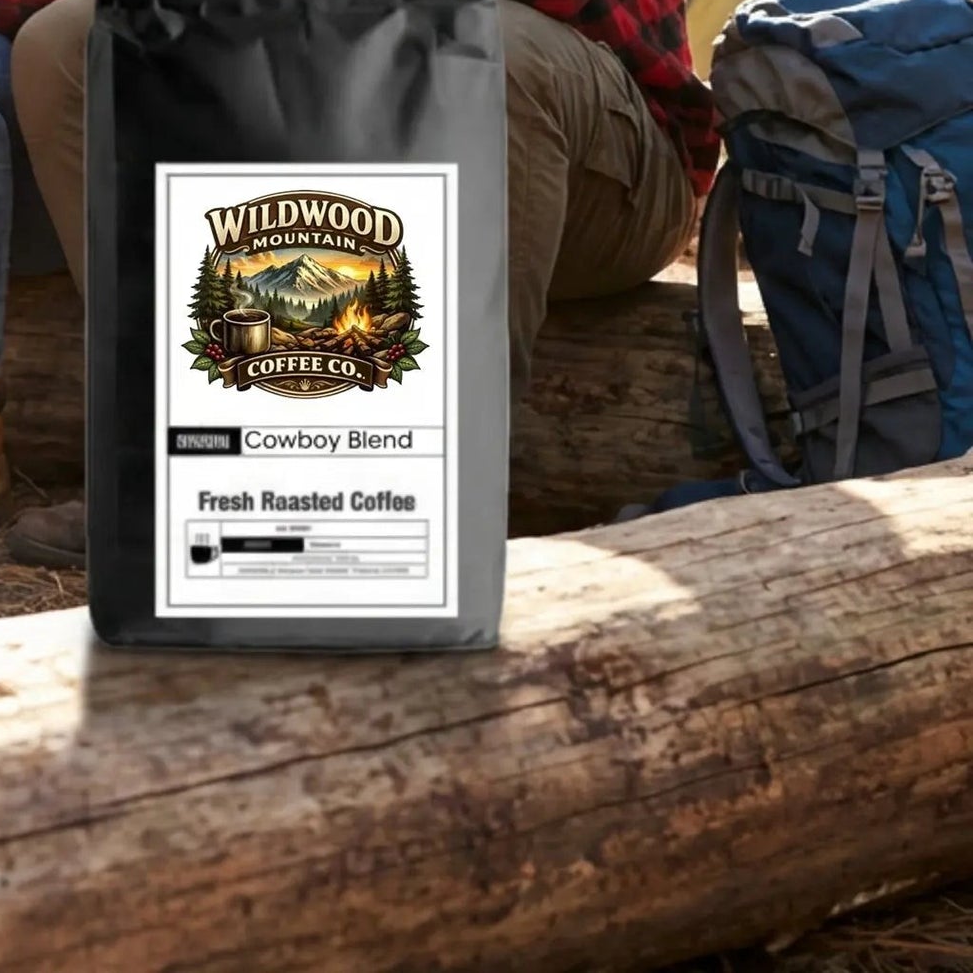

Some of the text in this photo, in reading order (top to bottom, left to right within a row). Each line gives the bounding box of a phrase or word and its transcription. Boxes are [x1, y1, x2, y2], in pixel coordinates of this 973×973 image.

[209, 199, 401, 247] WILDWOOD
[252, 232, 357, 251] MOUNTAIN
[247, 356, 323, 377] COFFEE
[244, 430, 341, 453] Cowboy
[348, 430, 413, 449] Blend
[198, 490, 254, 512] Fresh
